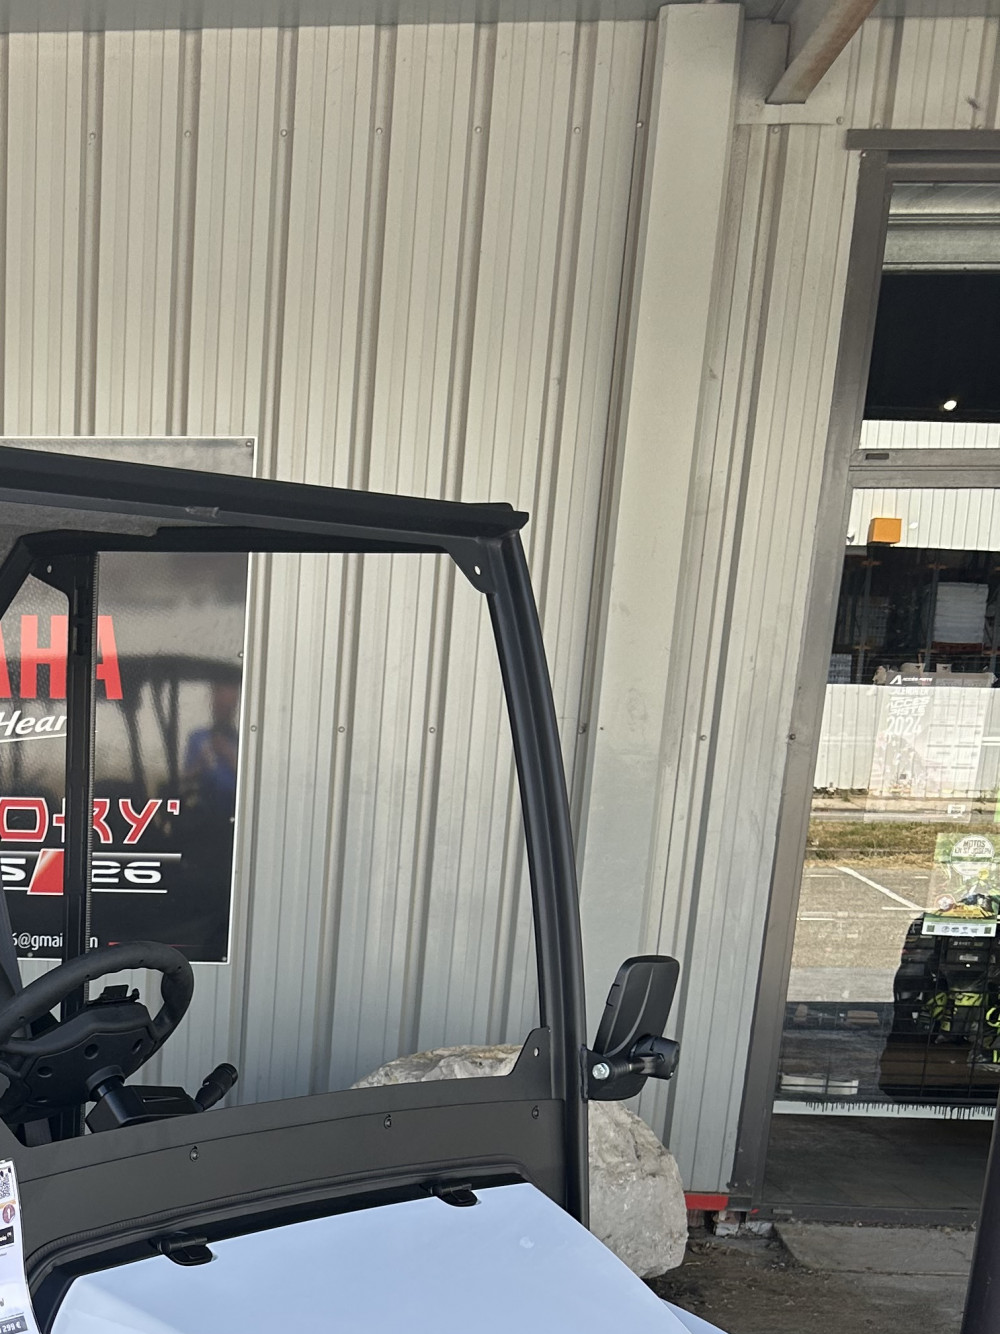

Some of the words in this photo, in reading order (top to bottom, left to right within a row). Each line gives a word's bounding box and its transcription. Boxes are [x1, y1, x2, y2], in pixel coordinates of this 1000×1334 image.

[887, 715, 922, 736] 2024
[91, 860, 162, 884] 26
[1, 1322, 16, 1333] 299
[16, 1321, 22, 1329] €
